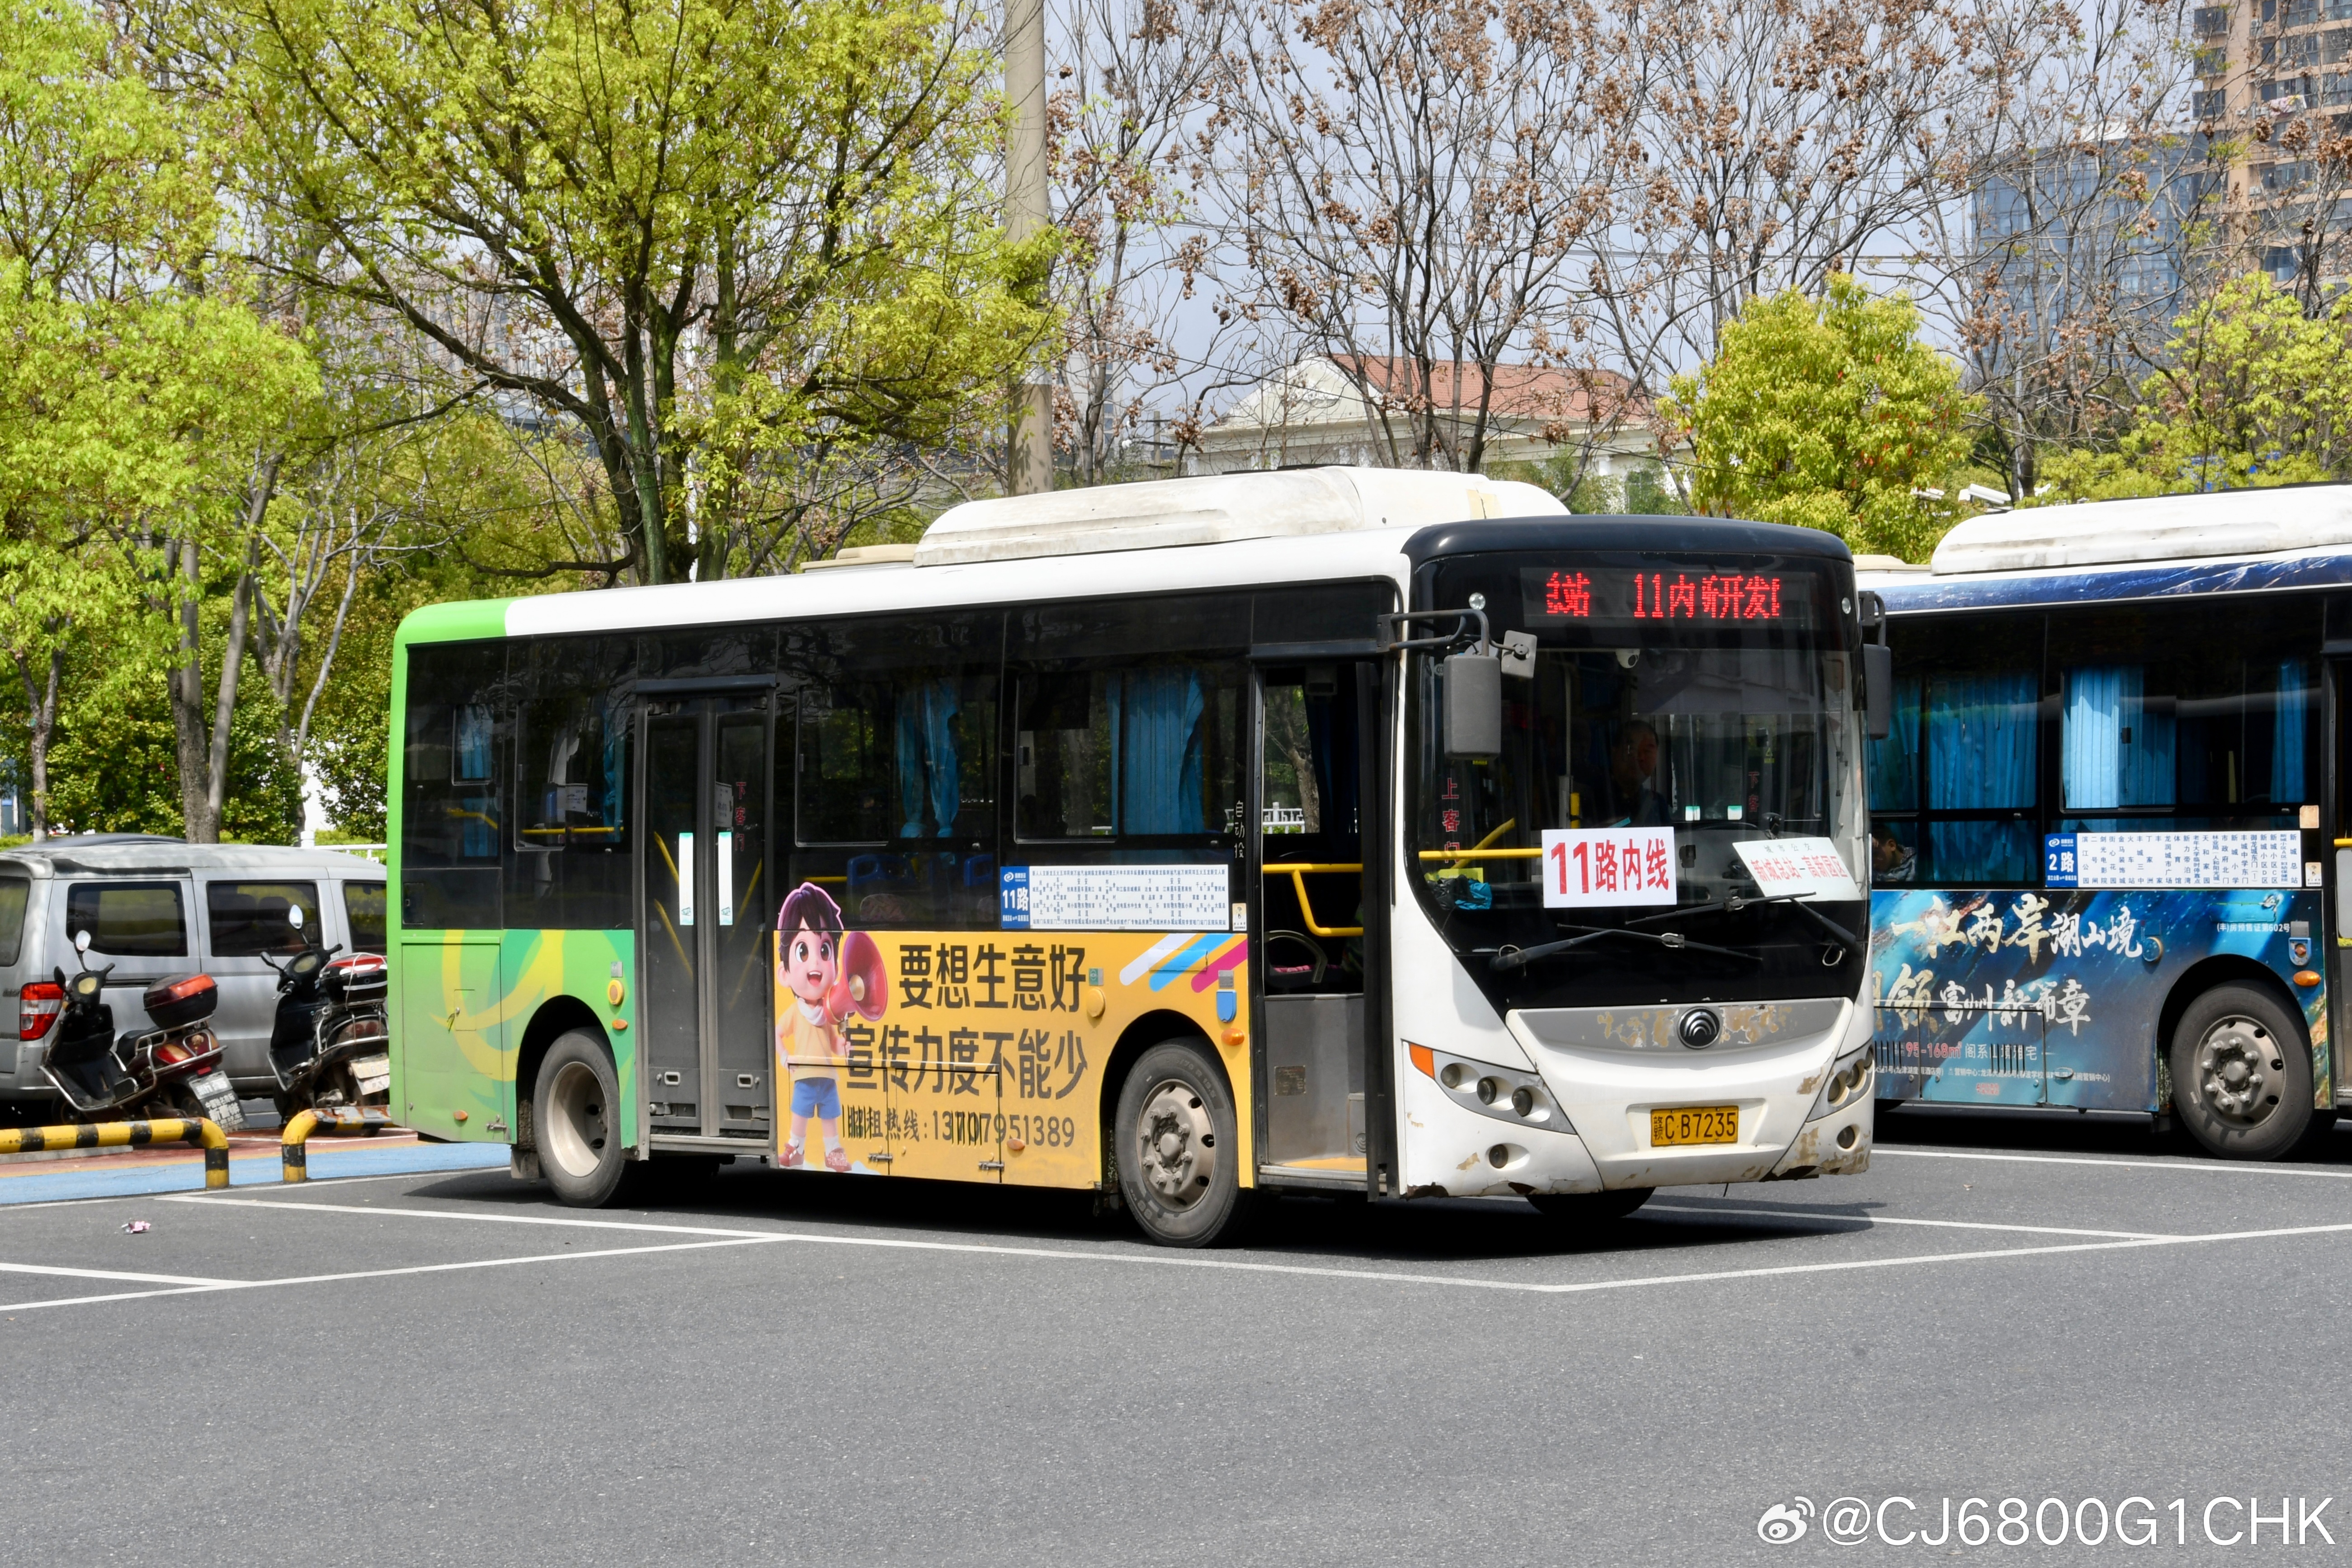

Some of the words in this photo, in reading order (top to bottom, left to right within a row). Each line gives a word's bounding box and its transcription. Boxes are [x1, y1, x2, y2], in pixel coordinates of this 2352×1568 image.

[734, 782, 746, 851] 下客门
[1442, 777, 1460, 863] 上客门
[1550, 838, 1670, 895] 11路内线
[2049, 851, 2074, 872] 2路
[1002, 886, 1029, 911] 11路
[2217, 923, 2291, 933] (丰)房预售证第602号
[899, 943, 1086, 1012] 要想生意好
[846, 1023, 1089, 1100] 宣传力度不能少
